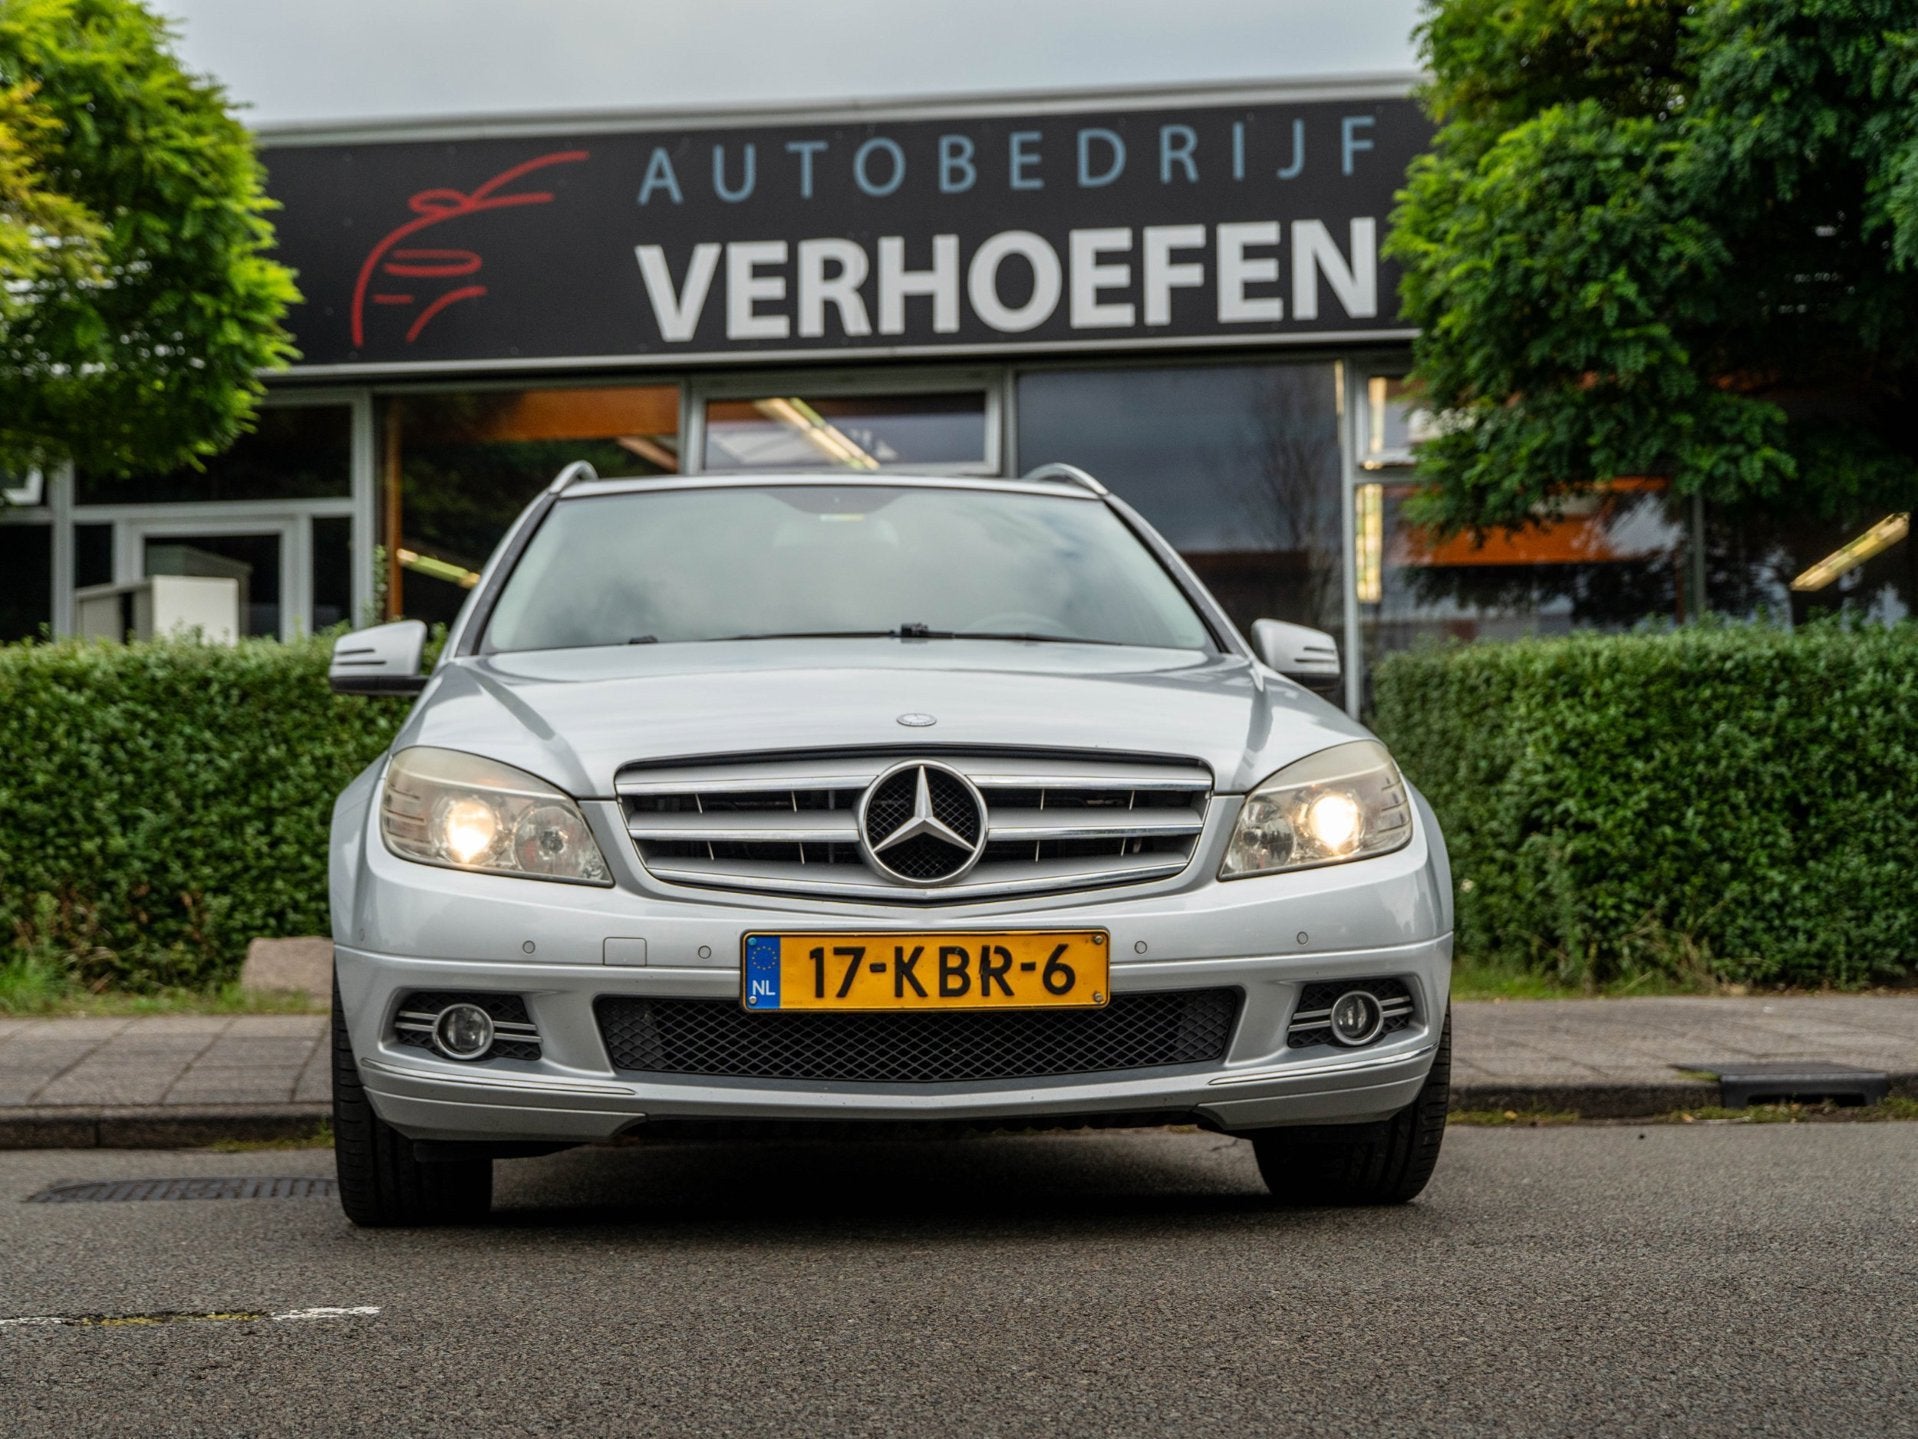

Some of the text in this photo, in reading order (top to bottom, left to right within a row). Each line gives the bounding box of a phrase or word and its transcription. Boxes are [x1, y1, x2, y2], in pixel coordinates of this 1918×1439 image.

[638, 115, 1377, 206] AUTOBEDRIJF
[634, 216, 1379, 343] VERHOEFEN
[752, 979, 776, 997] NL
[808, 943, 1077, 999] 17-KBR-6
